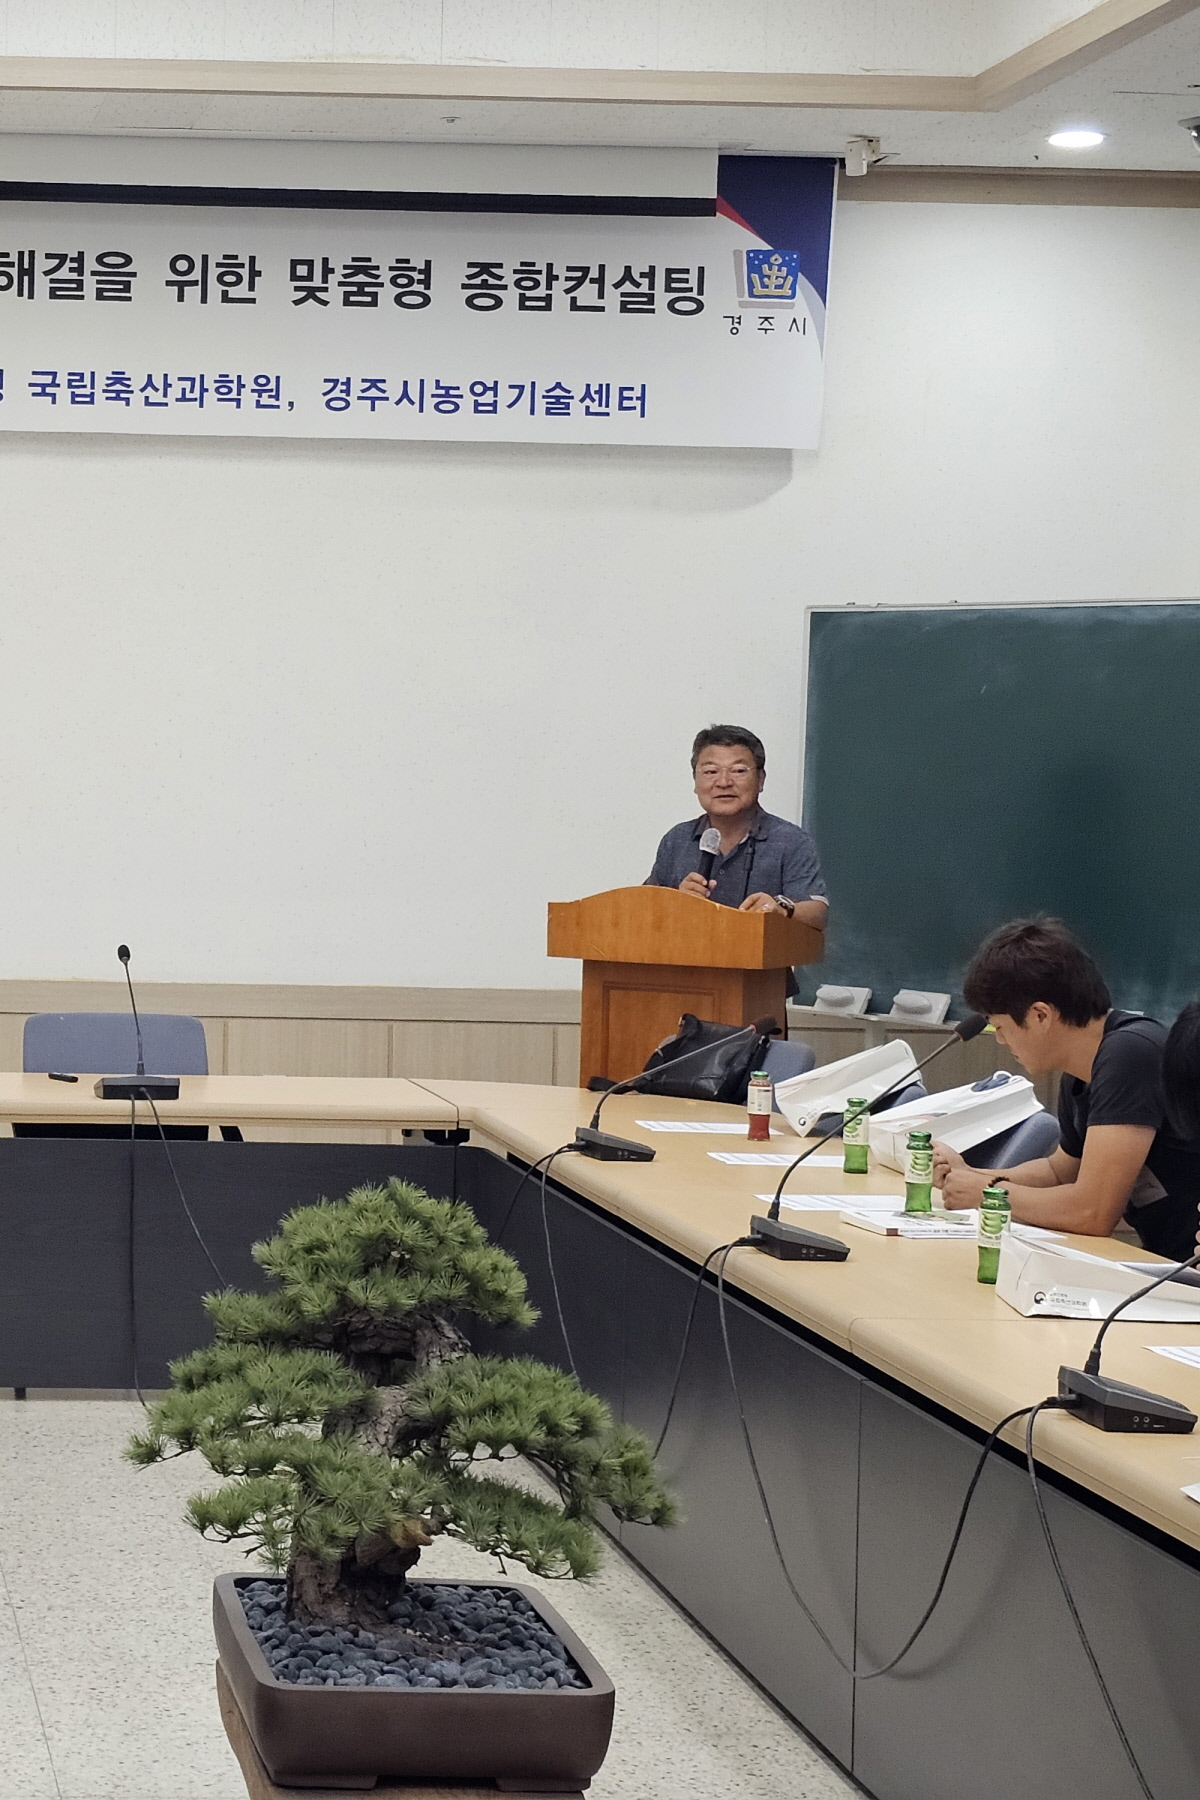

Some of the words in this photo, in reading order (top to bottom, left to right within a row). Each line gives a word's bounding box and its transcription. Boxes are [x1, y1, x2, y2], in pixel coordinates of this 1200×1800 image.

[165, 253, 263, 305] 위한
[289, 256, 432, 310] 맞춤형
[460, 261, 706, 316] 종합컨설팅
[27, 370, 295, 412] 국립축산과학원,
[321, 376, 647, 419] 경주시농업기술센터
